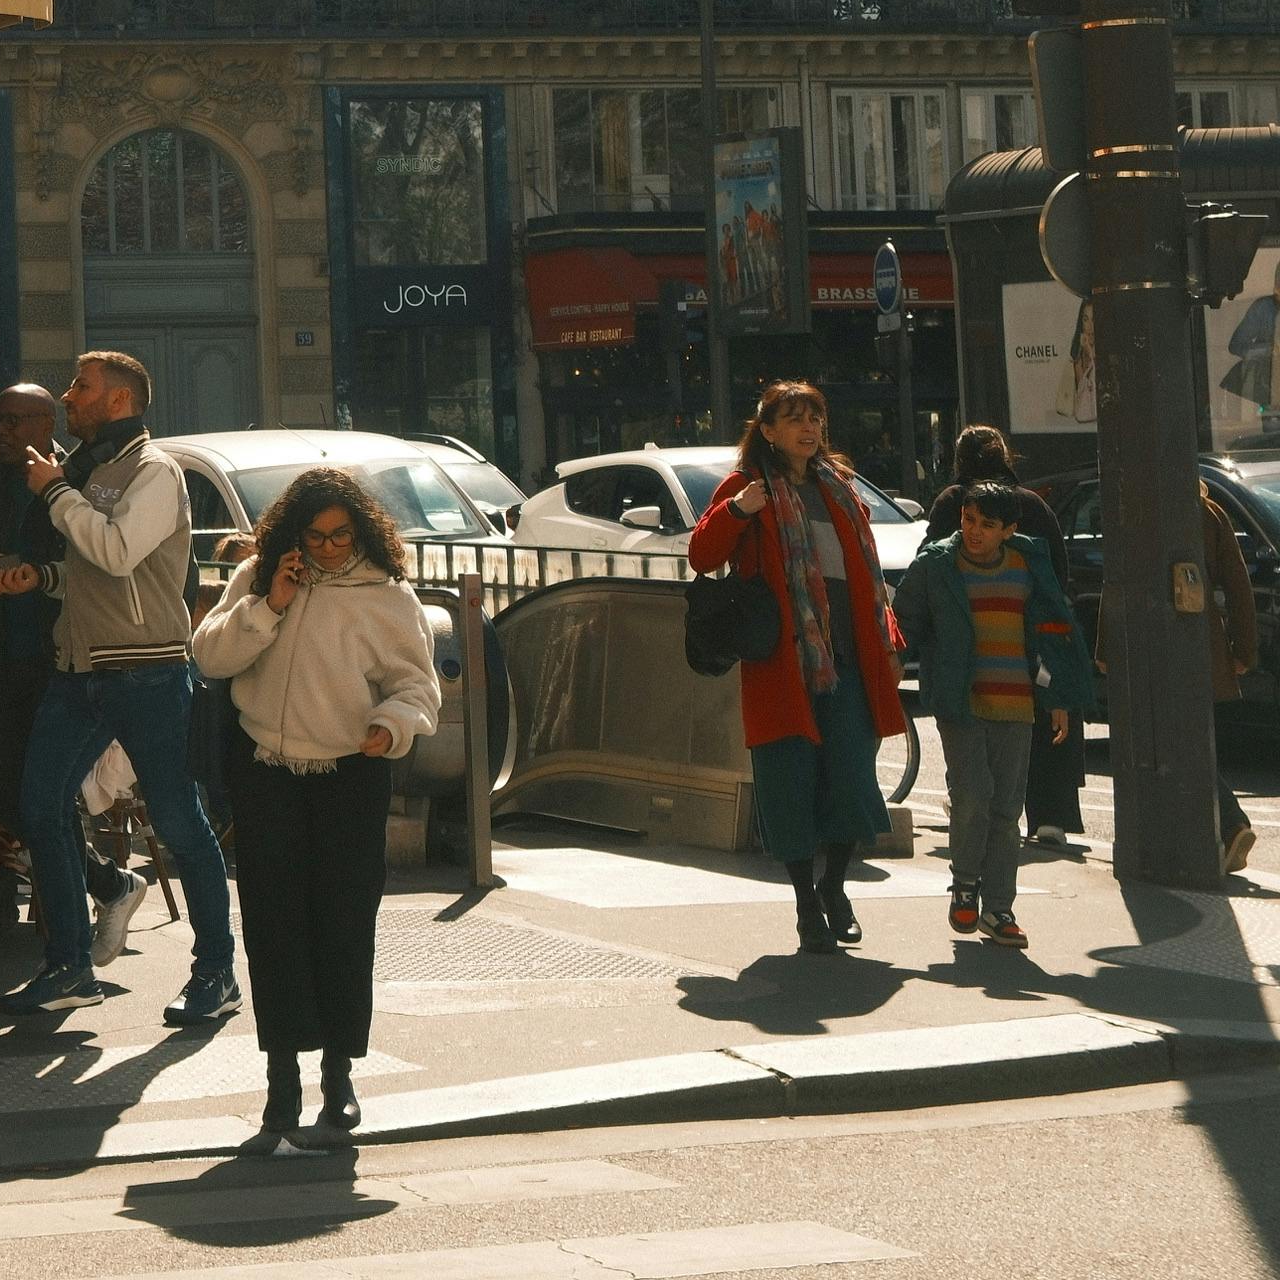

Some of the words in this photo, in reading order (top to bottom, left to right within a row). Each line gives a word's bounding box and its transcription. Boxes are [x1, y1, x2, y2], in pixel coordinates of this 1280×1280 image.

[375, 157, 442, 174] SYNDIC
[383, 284, 468, 313] JOYA
[817, 286, 920, 301] BRASSIE
[297, 334, 312, 345] 59
[576, 330, 587, 343] BAR
[590, 328, 623, 342] RESTAURANT
[1015, 344, 1058, 359] CHANEL
